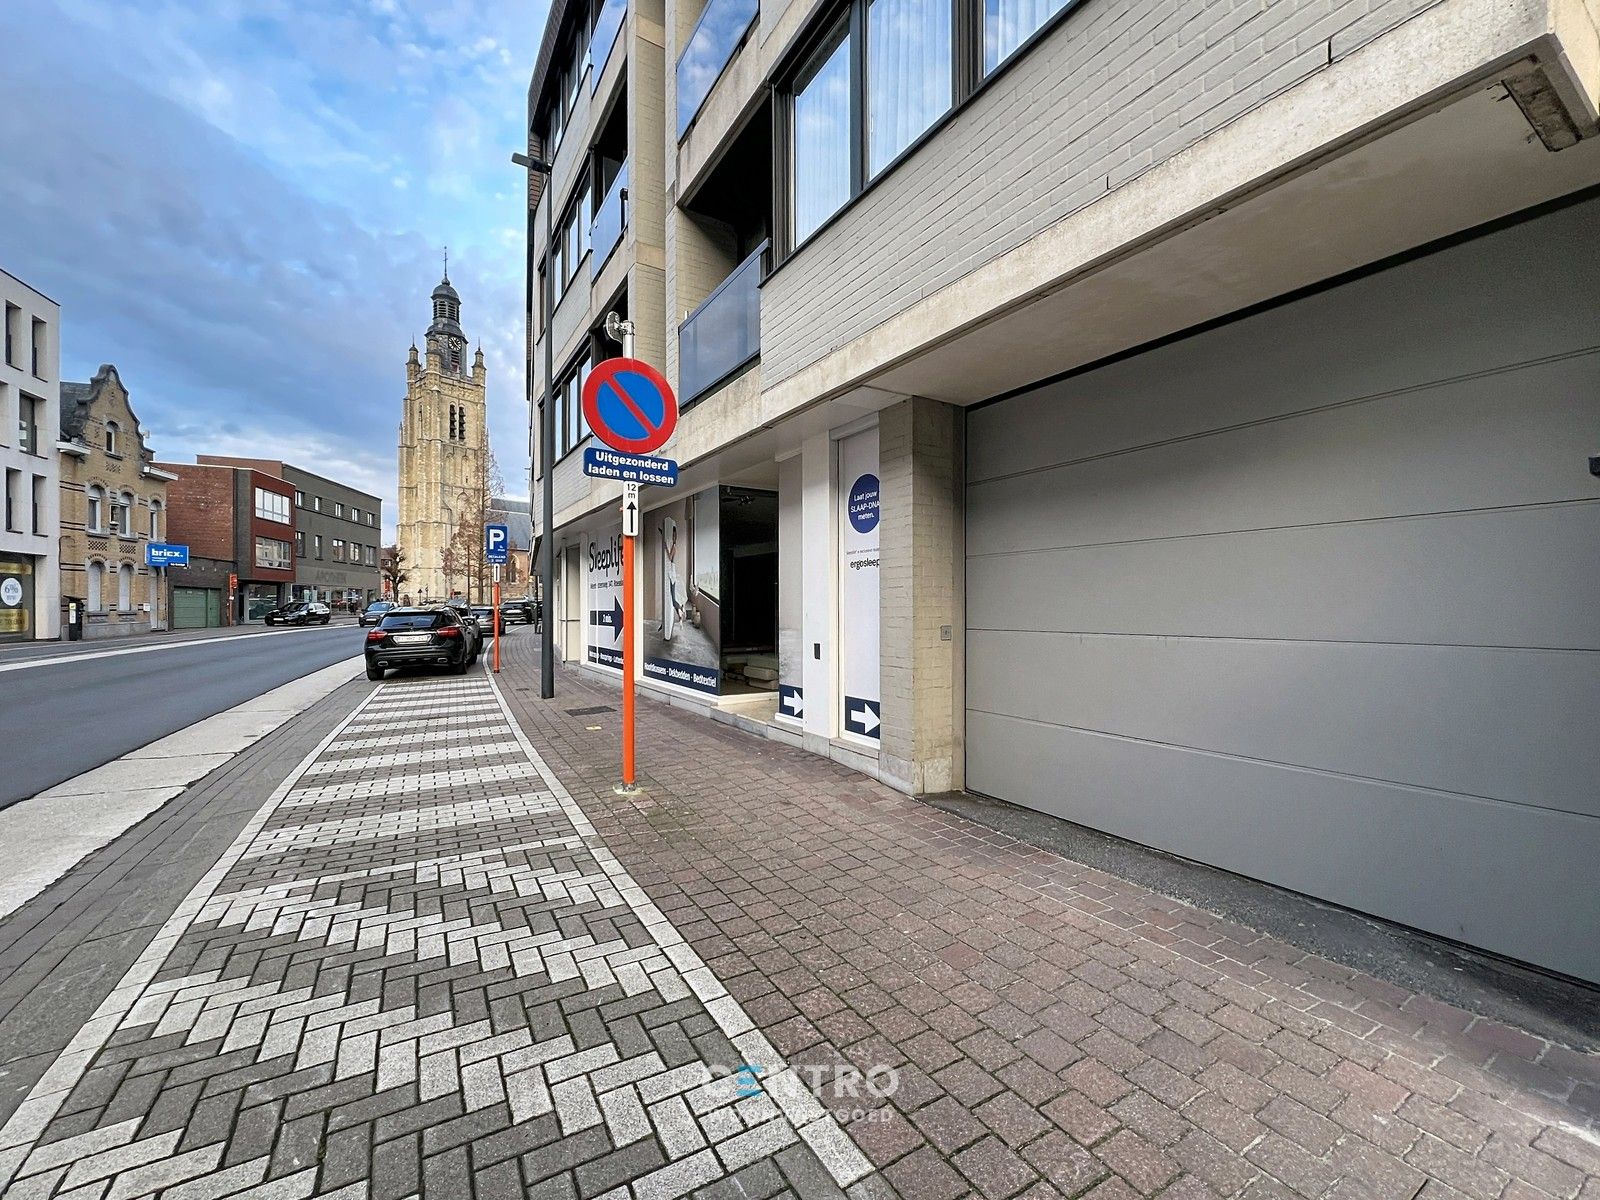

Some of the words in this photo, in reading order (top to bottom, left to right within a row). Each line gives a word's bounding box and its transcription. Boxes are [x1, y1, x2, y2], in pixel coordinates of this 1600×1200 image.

[595, 451, 669, 471] Uitgezonderd
[588, 463, 620, 477] laden
[623, 469, 637, 480] en
[639, 470, 674, 485] lossen
[627, 483, 636, 492] 12
[854, 493, 864, 502] Laat
[865, 491, 877, 501] jouw
[858, 512, 875, 520] meten.
[489, 529, 505, 550] P
[668, 667, 691, 681] Dekbedden
[693, 673, 717, 687] Bedtextiel
